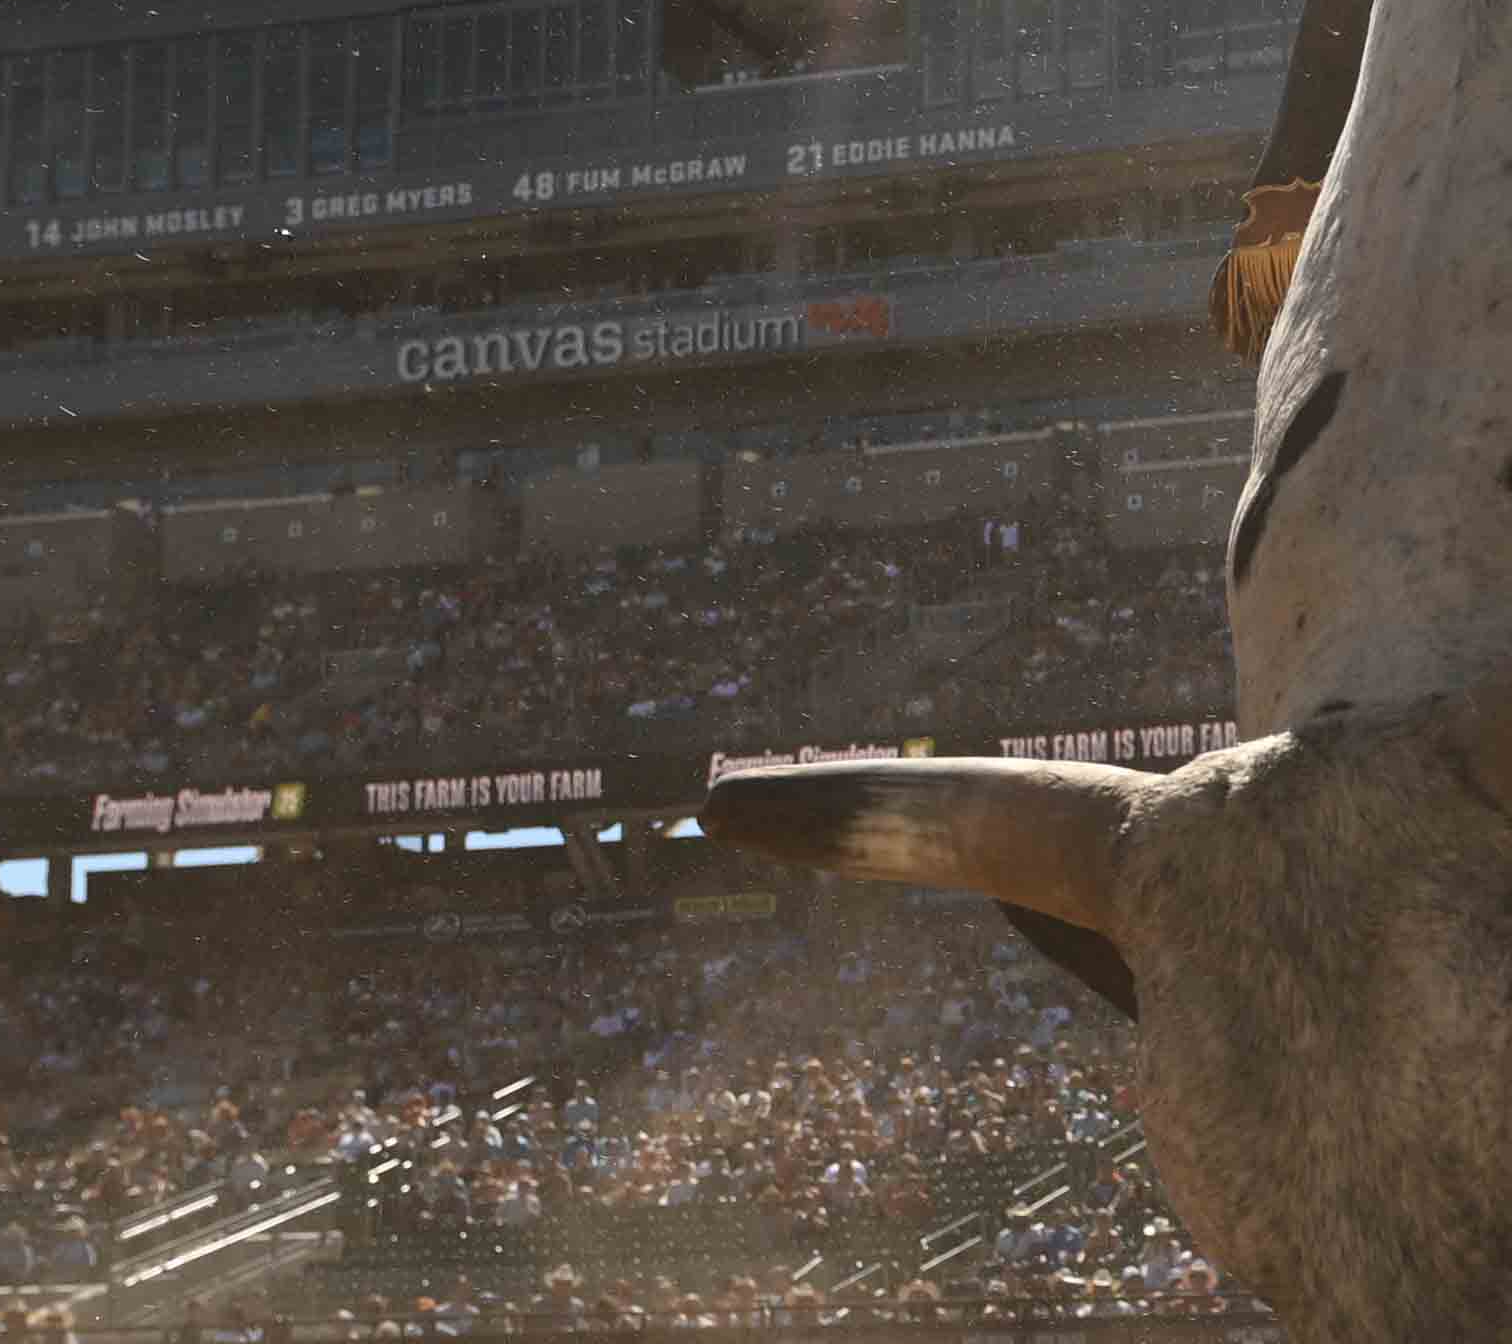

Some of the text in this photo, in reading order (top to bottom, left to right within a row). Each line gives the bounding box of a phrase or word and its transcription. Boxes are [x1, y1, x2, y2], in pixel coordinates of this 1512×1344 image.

[787, 123, 1016, 175] 21 EDDIE HANNA
[512, 171, 556, 201] 48
[631, 154, 749, 188] McGRAW
[25, 217, 64, 248] 14
[285, 196, 305, 227] 3
[396, 316, 625, 383] canvas
[631, 310, 801, 361] stadium
[999, 735, 1050, 761] THIS
[1052, 730, 1108, 764] FARM
[1112, 728, 1136, 762] IS
[1140, 723, 1195, 759] YOUR
[91, 793, 175, 832] Farming
[175, 787, 272, 827] Simulator
[367, 768, 602, 813] THIS FARM IS YOUR FARM
